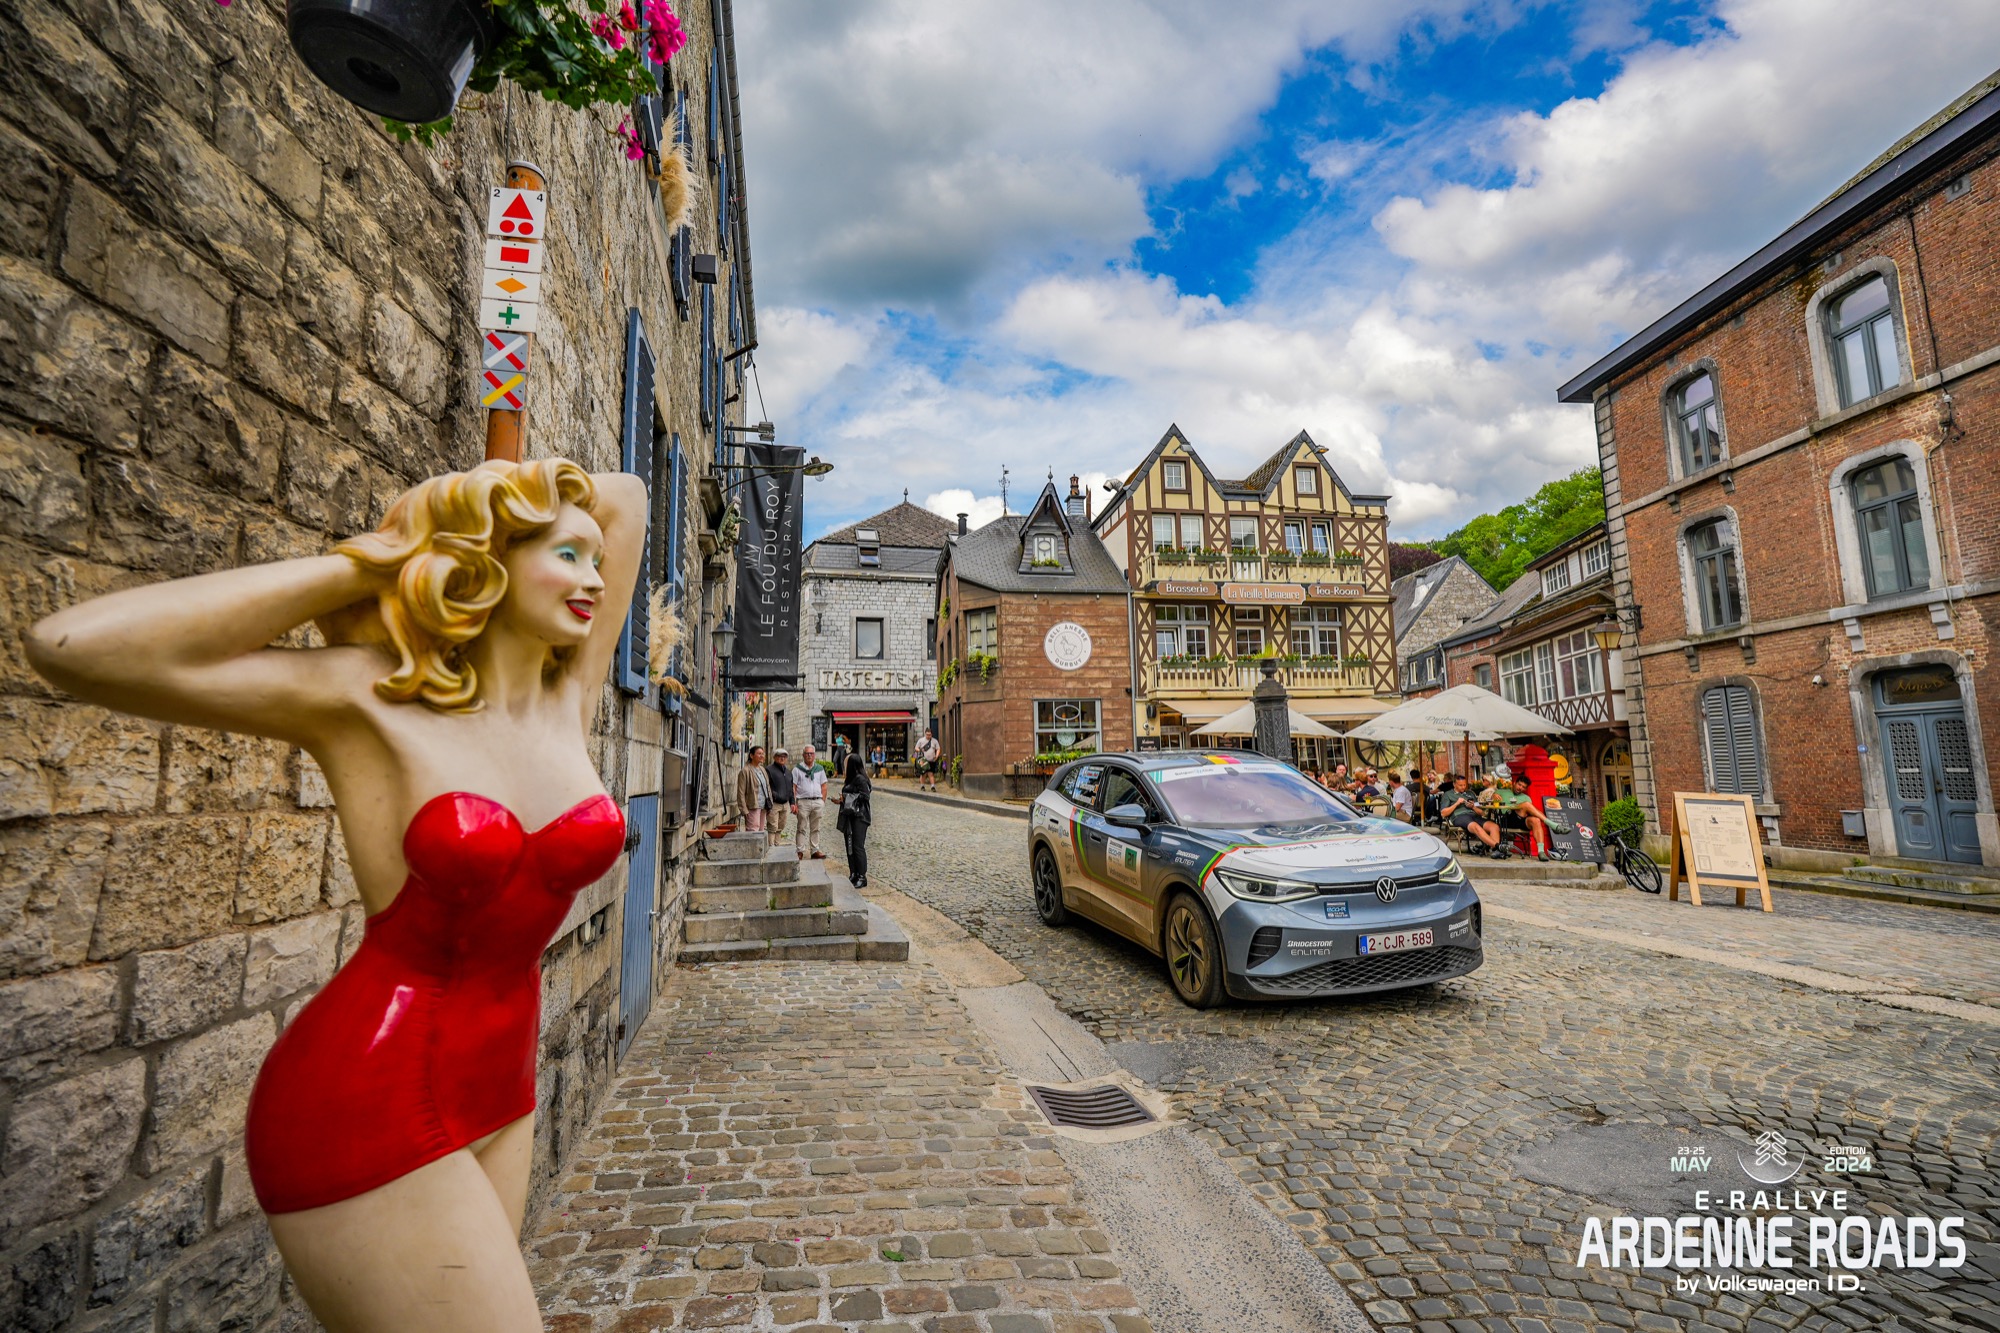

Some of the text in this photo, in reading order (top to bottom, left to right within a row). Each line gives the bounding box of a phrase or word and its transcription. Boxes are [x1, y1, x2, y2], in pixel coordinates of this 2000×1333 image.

[494, 188, 501, 198] 2
[536, 193, 544, 203] 4
[760, 480, 780, 637] LE FOU DU ROY
[780, 491, 793, 628] RESTAURANT
[1165, 583, 1209, 593] Brasserie
[1315, 585, 1360, 596] Tea-Room
[1228, 587, 1300, 600] La Vieille Demeure
[741, 656, 790, 665] lefouduroy.com
[1054, 657, 1082, 668] DURBUY
[1449, 926, 1469, 939] ENLITEN
[1287, 940, 1334, 948] BRIDGESTONE
[1290, 948, 1331, 956] ENLITEN
